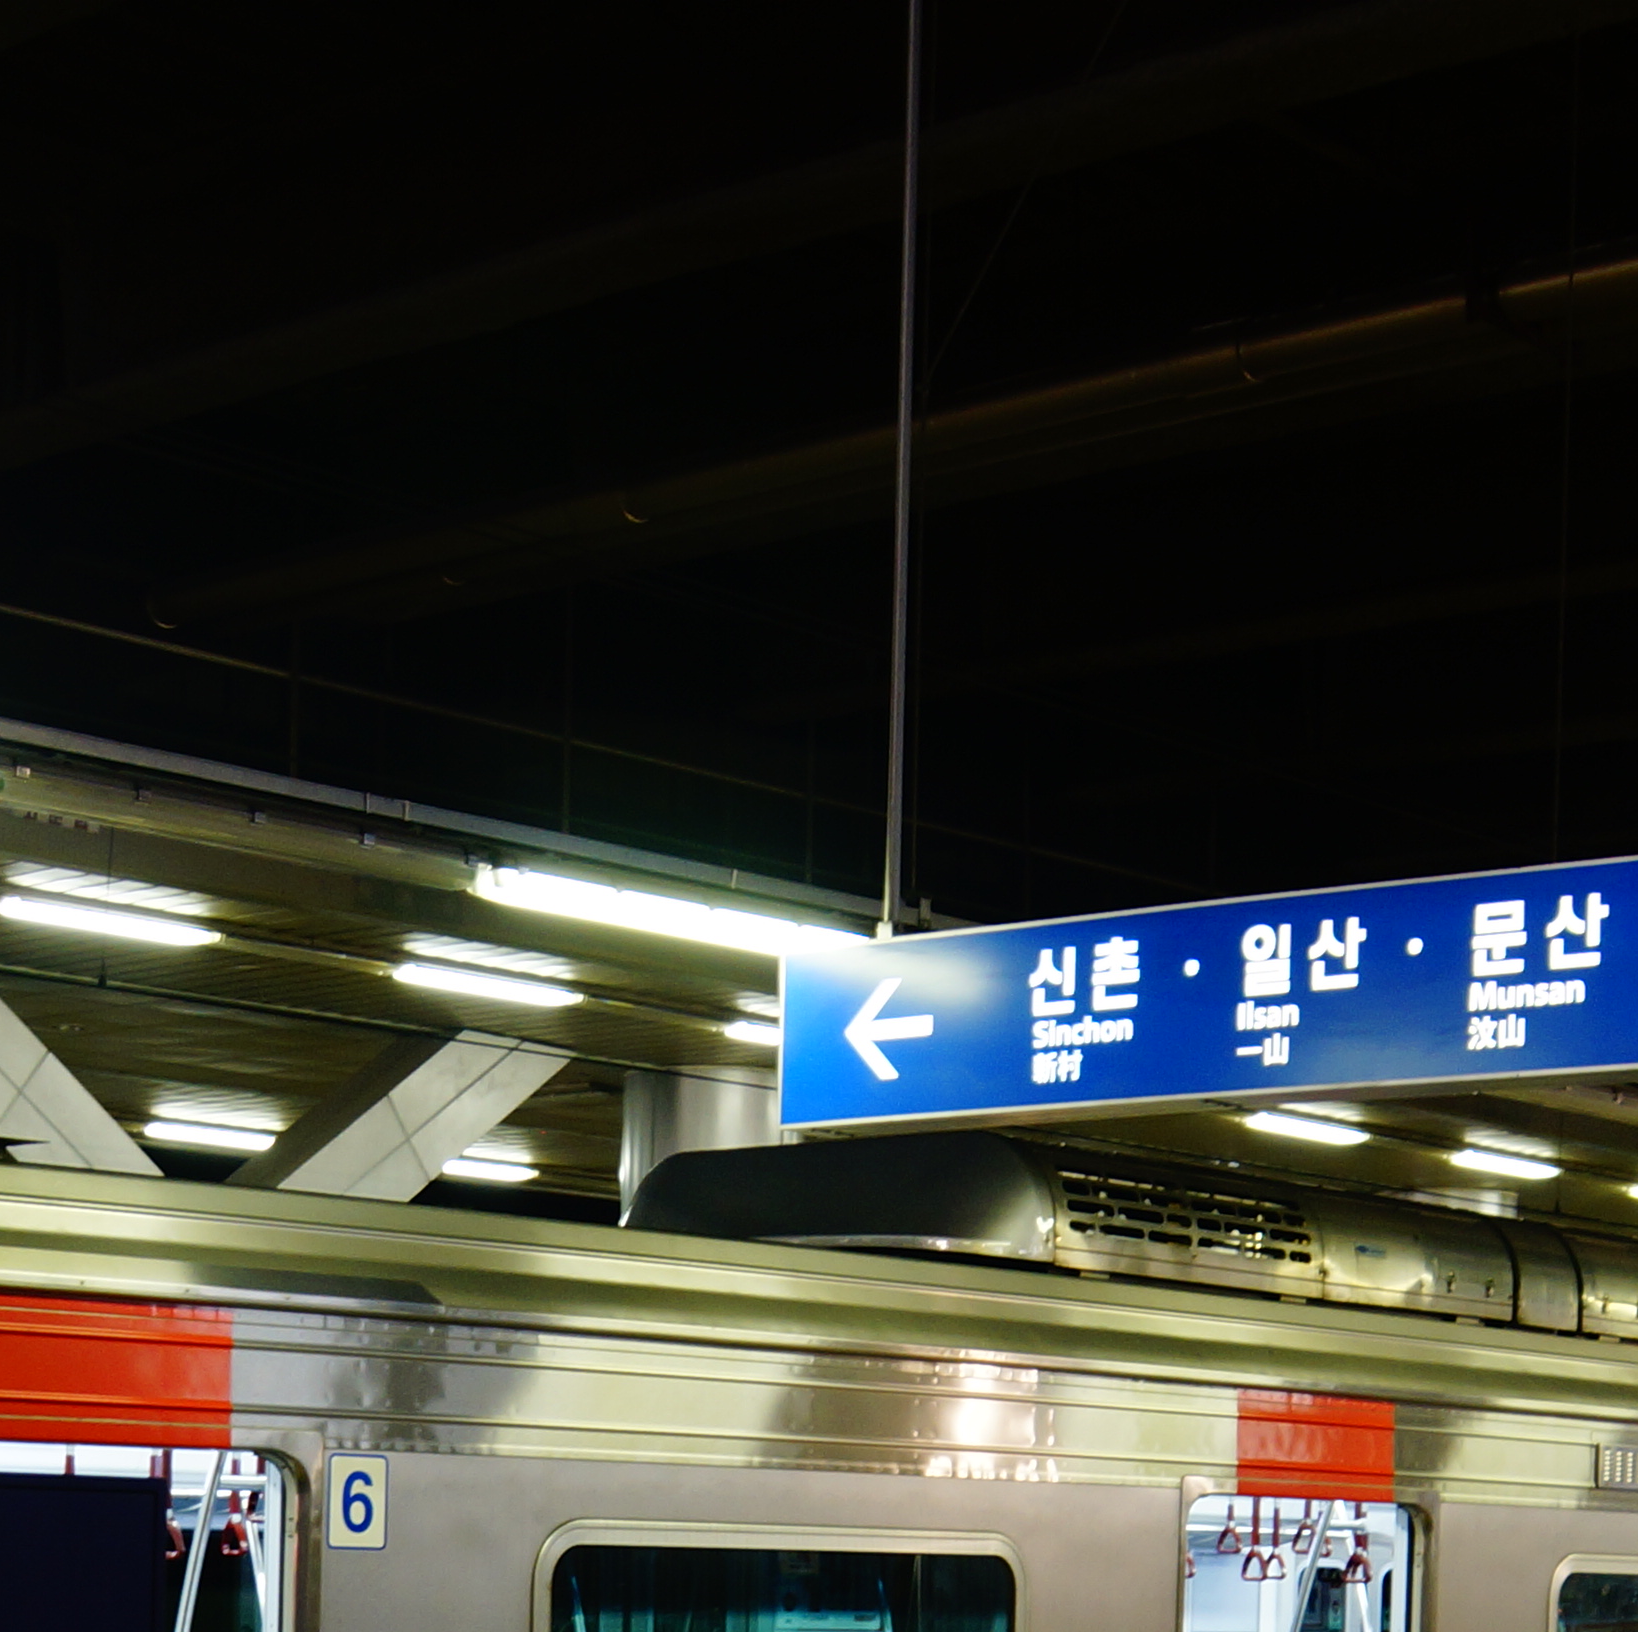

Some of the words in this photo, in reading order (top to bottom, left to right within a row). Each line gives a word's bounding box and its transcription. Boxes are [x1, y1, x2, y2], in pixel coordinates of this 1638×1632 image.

[1029, 937, 1140, 1017] 신촌
[1241, 916, 1367, 997] 일산
[1471, 892, 1610, 977] 문산
[1032, 1015, 1134, 1049] Sinchon
[1236, 1000, 1300, 1031] Ilsan
[1468, 979, 1585, 1012] Munsan
[1032, 1049, 1083, 1084] 新村
[1235, 1033, 1290, 1066] 一山
[342, 1470, 373, 1533] 6
